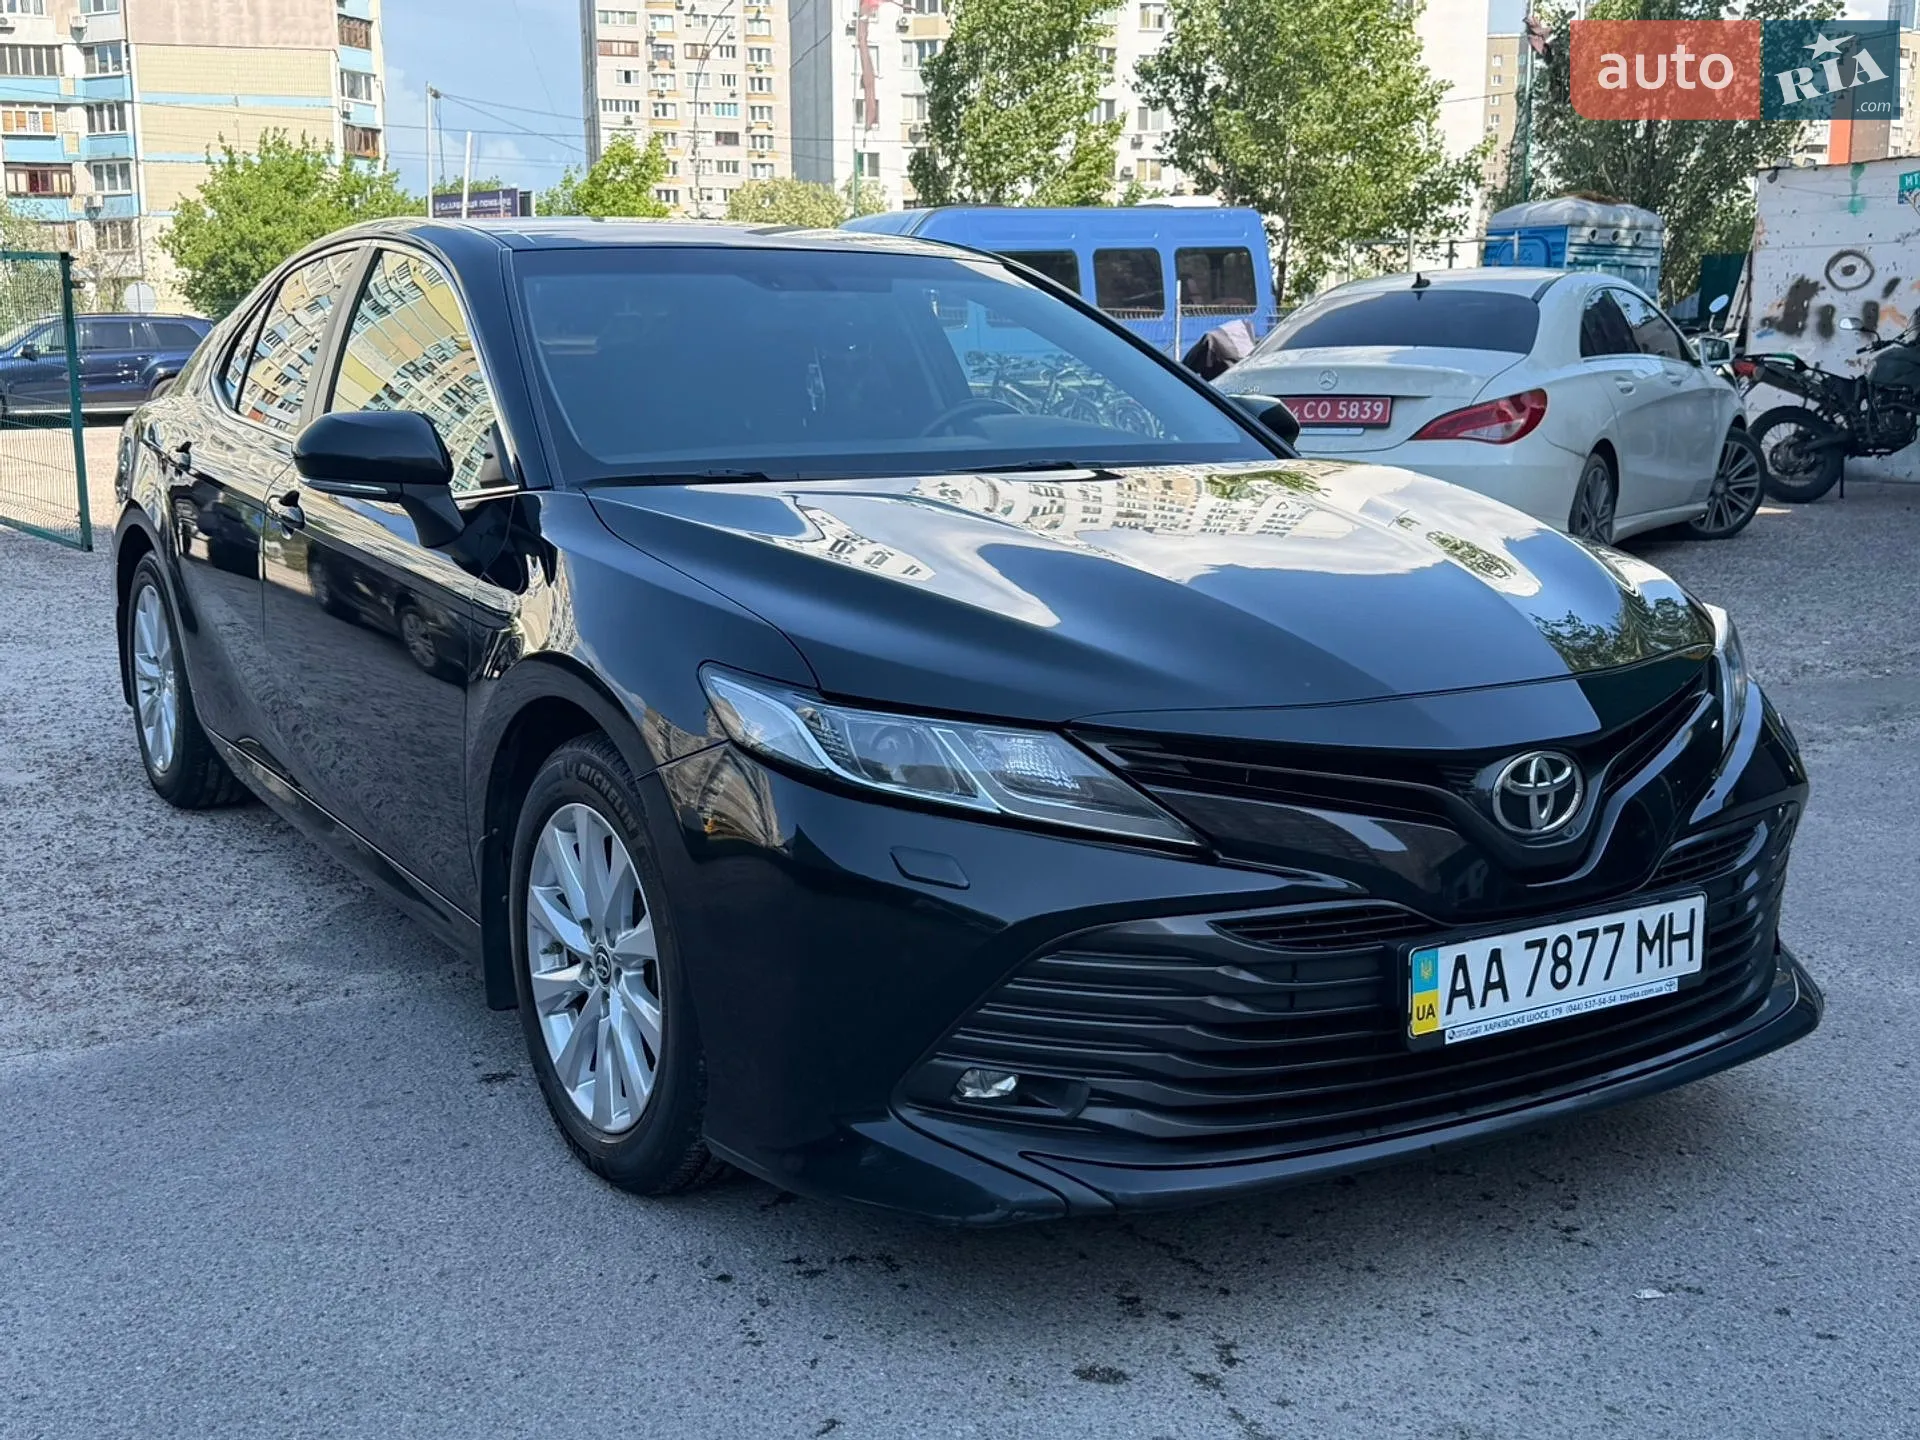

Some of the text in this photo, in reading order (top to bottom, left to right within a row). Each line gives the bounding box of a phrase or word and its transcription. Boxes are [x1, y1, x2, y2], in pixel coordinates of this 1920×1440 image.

[1304, 401, 1331, 419] CO
[1337, 401, 1384, 419] 5839
[578, 763, 638, 833] MICHELIN
[1445, 908, 1695, 1016] AA 7877 MH
[1417, 1003, 1436, 1022] UA
[1483, 1014, 1525, 1032] ХАРКІВСЬКЕ
[1619, 986, 1663, 1002] toyota.com.ua
